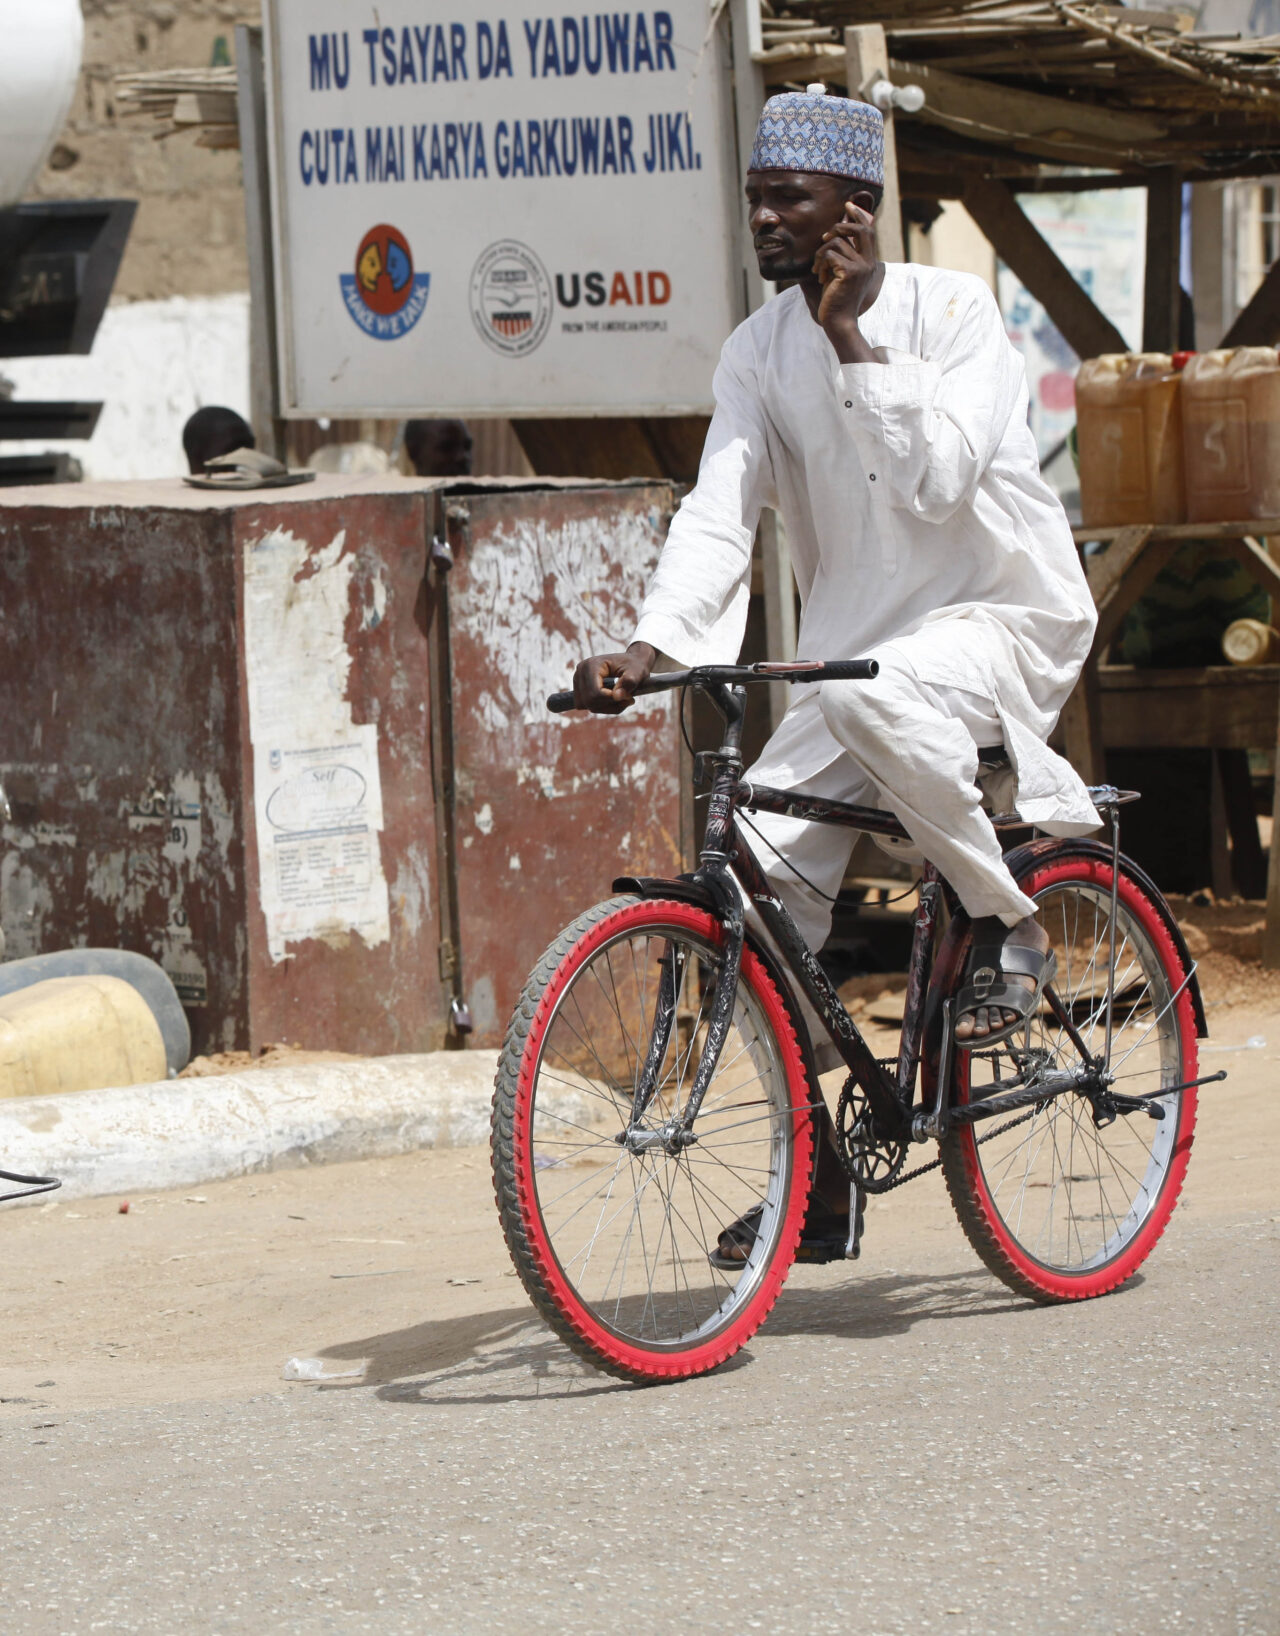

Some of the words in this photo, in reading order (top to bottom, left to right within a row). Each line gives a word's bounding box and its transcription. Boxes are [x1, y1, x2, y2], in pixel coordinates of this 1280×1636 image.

[309, 32, 349, 91] MU
[363, 23, 468, 87] TSAYAR
[477, 20, 514, 80] DA
[524, 11, 677, 78] YADUWAR
[300, 129, 359, 187] CUTA
[366, 126, 406, 182] MAI
[413, 122, 489, 181] KARYA
[494, 116, 637, 178] GARKUWAR
[554, 271, 672, 309] USAID
